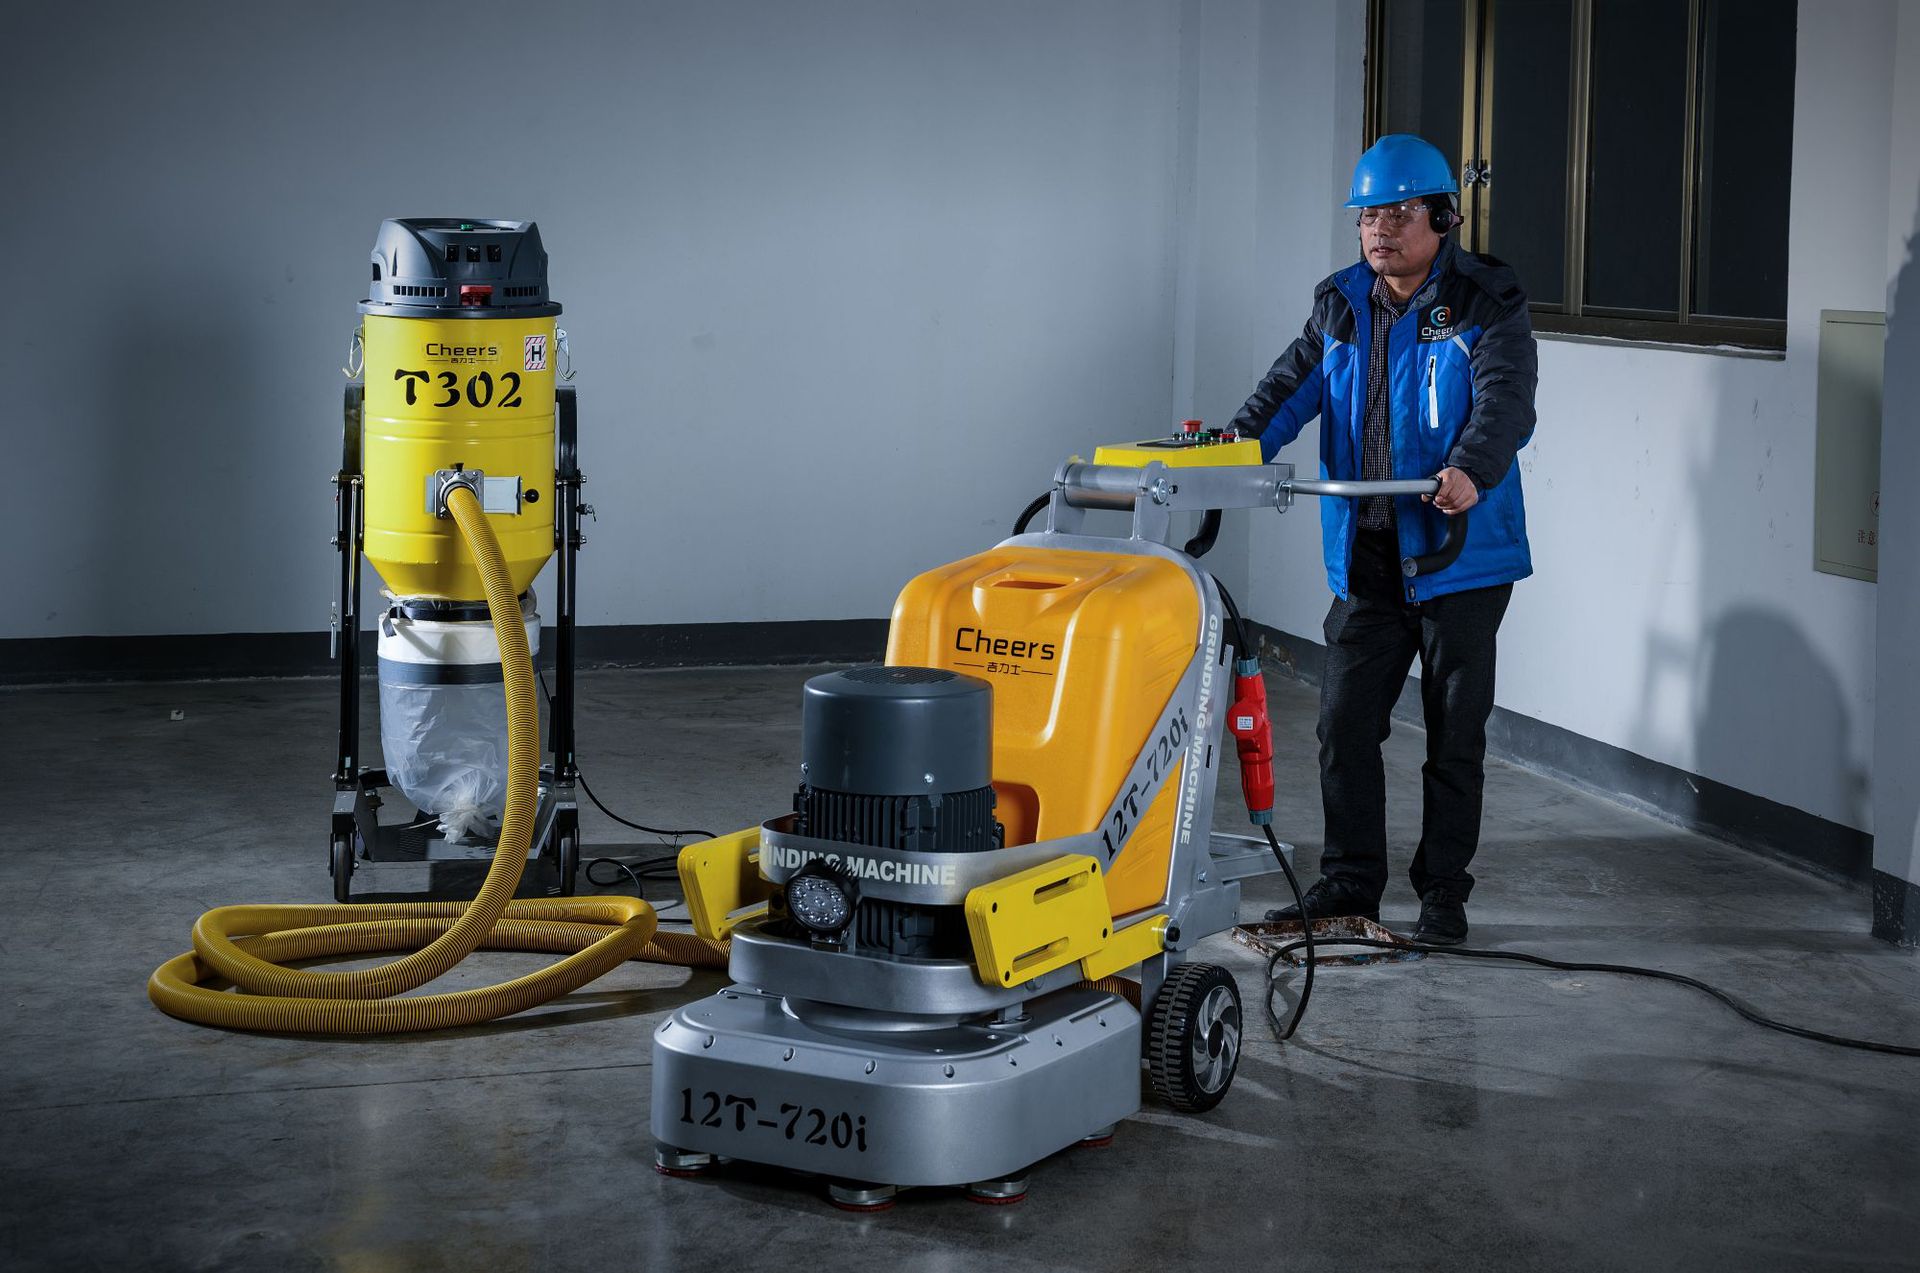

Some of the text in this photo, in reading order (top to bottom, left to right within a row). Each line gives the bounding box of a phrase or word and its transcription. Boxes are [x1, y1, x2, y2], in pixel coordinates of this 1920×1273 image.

[426, 343, 497, 356] Cheers
[531, 345, 542, 361] H
[394, 368, 522, 408] T302
[955, 627, 1055, 661] Cheers
[987, 661, 1022, 676] 吉力士
[1180, 614, 1218, 845] GRINDING MACHINE
[1102, 706, 1189, 862] 12T-720i
[846, 855, 956, 885] MACHINE
[680, 1087, 868, 1152] 12T-720i
